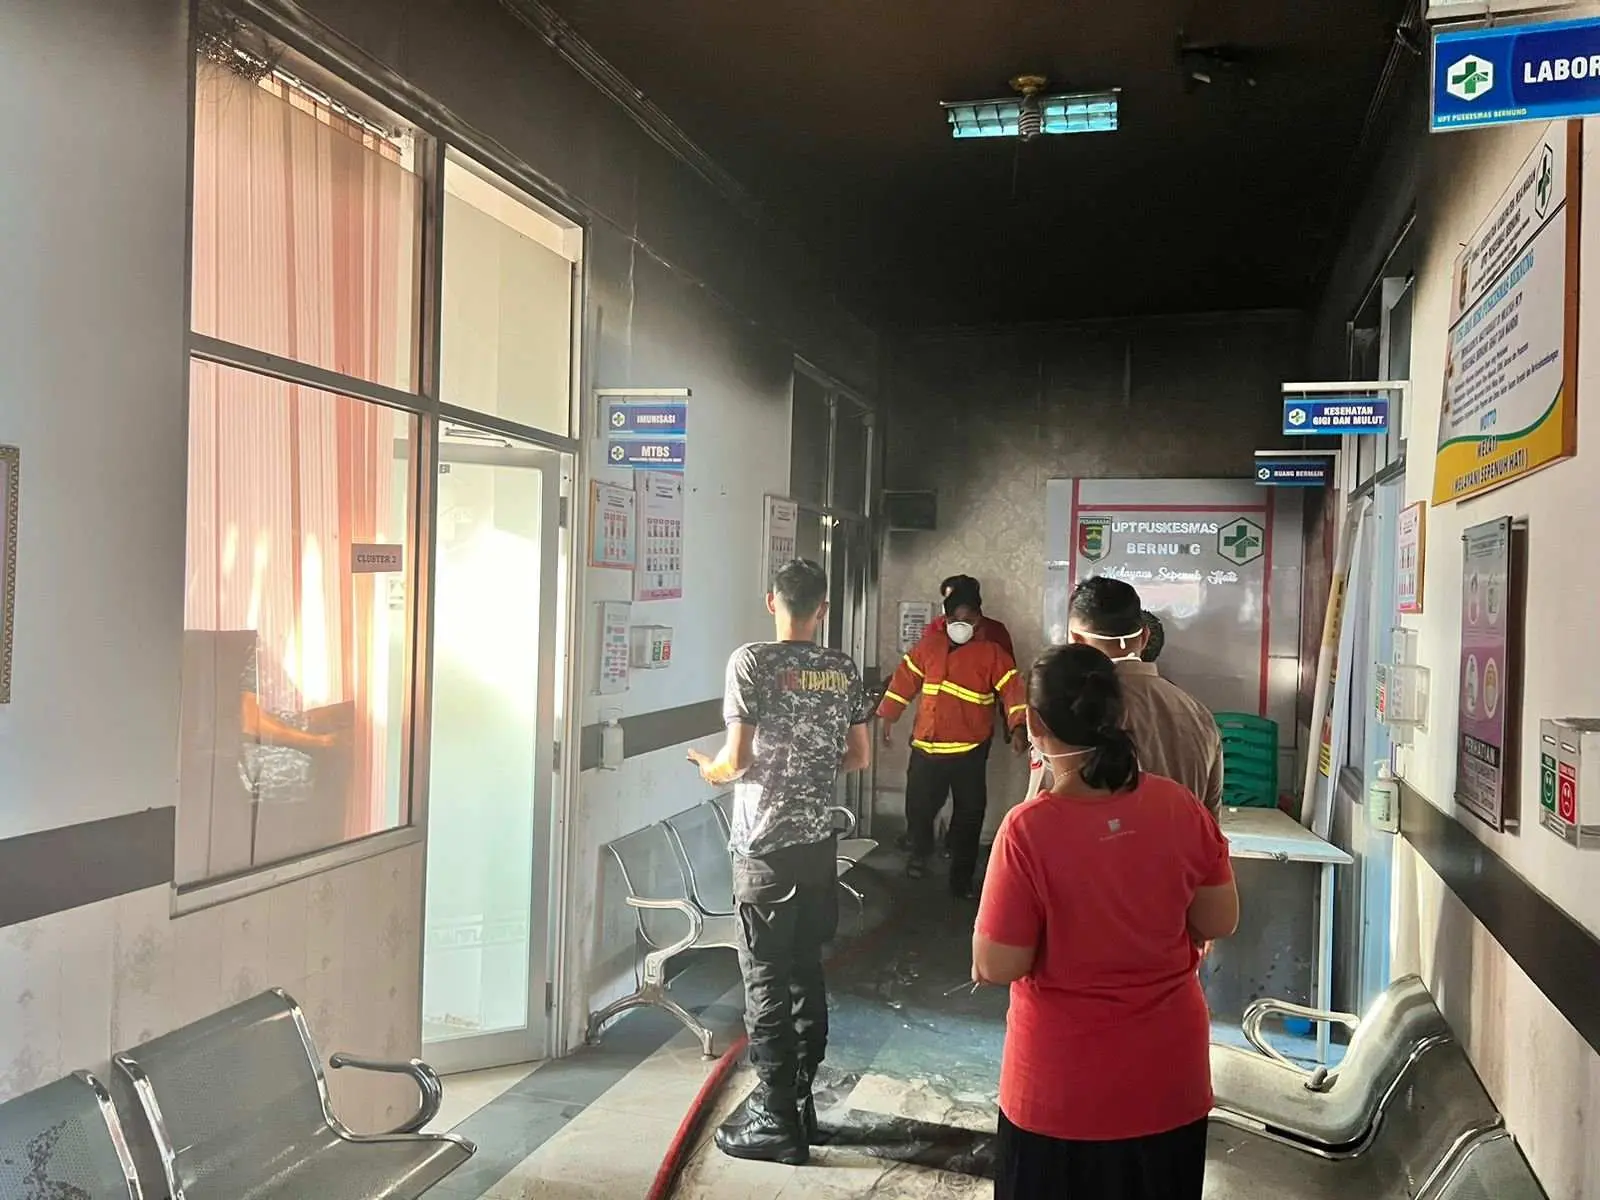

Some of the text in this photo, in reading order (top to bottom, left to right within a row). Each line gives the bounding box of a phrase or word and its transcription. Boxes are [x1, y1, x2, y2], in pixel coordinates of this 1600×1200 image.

[1323, 406, 1374, 416] KESEHATAN
[636, 414, 676, 424] IMUNISASI
[1312, 416, 1383, 425] GIGI DAN MULUT
[641, 446, 670, 457] MTBS
[1138, 522, 1218, 534] PUSKESMAS
[1126, 543, 1200, 555] BERNUNG
